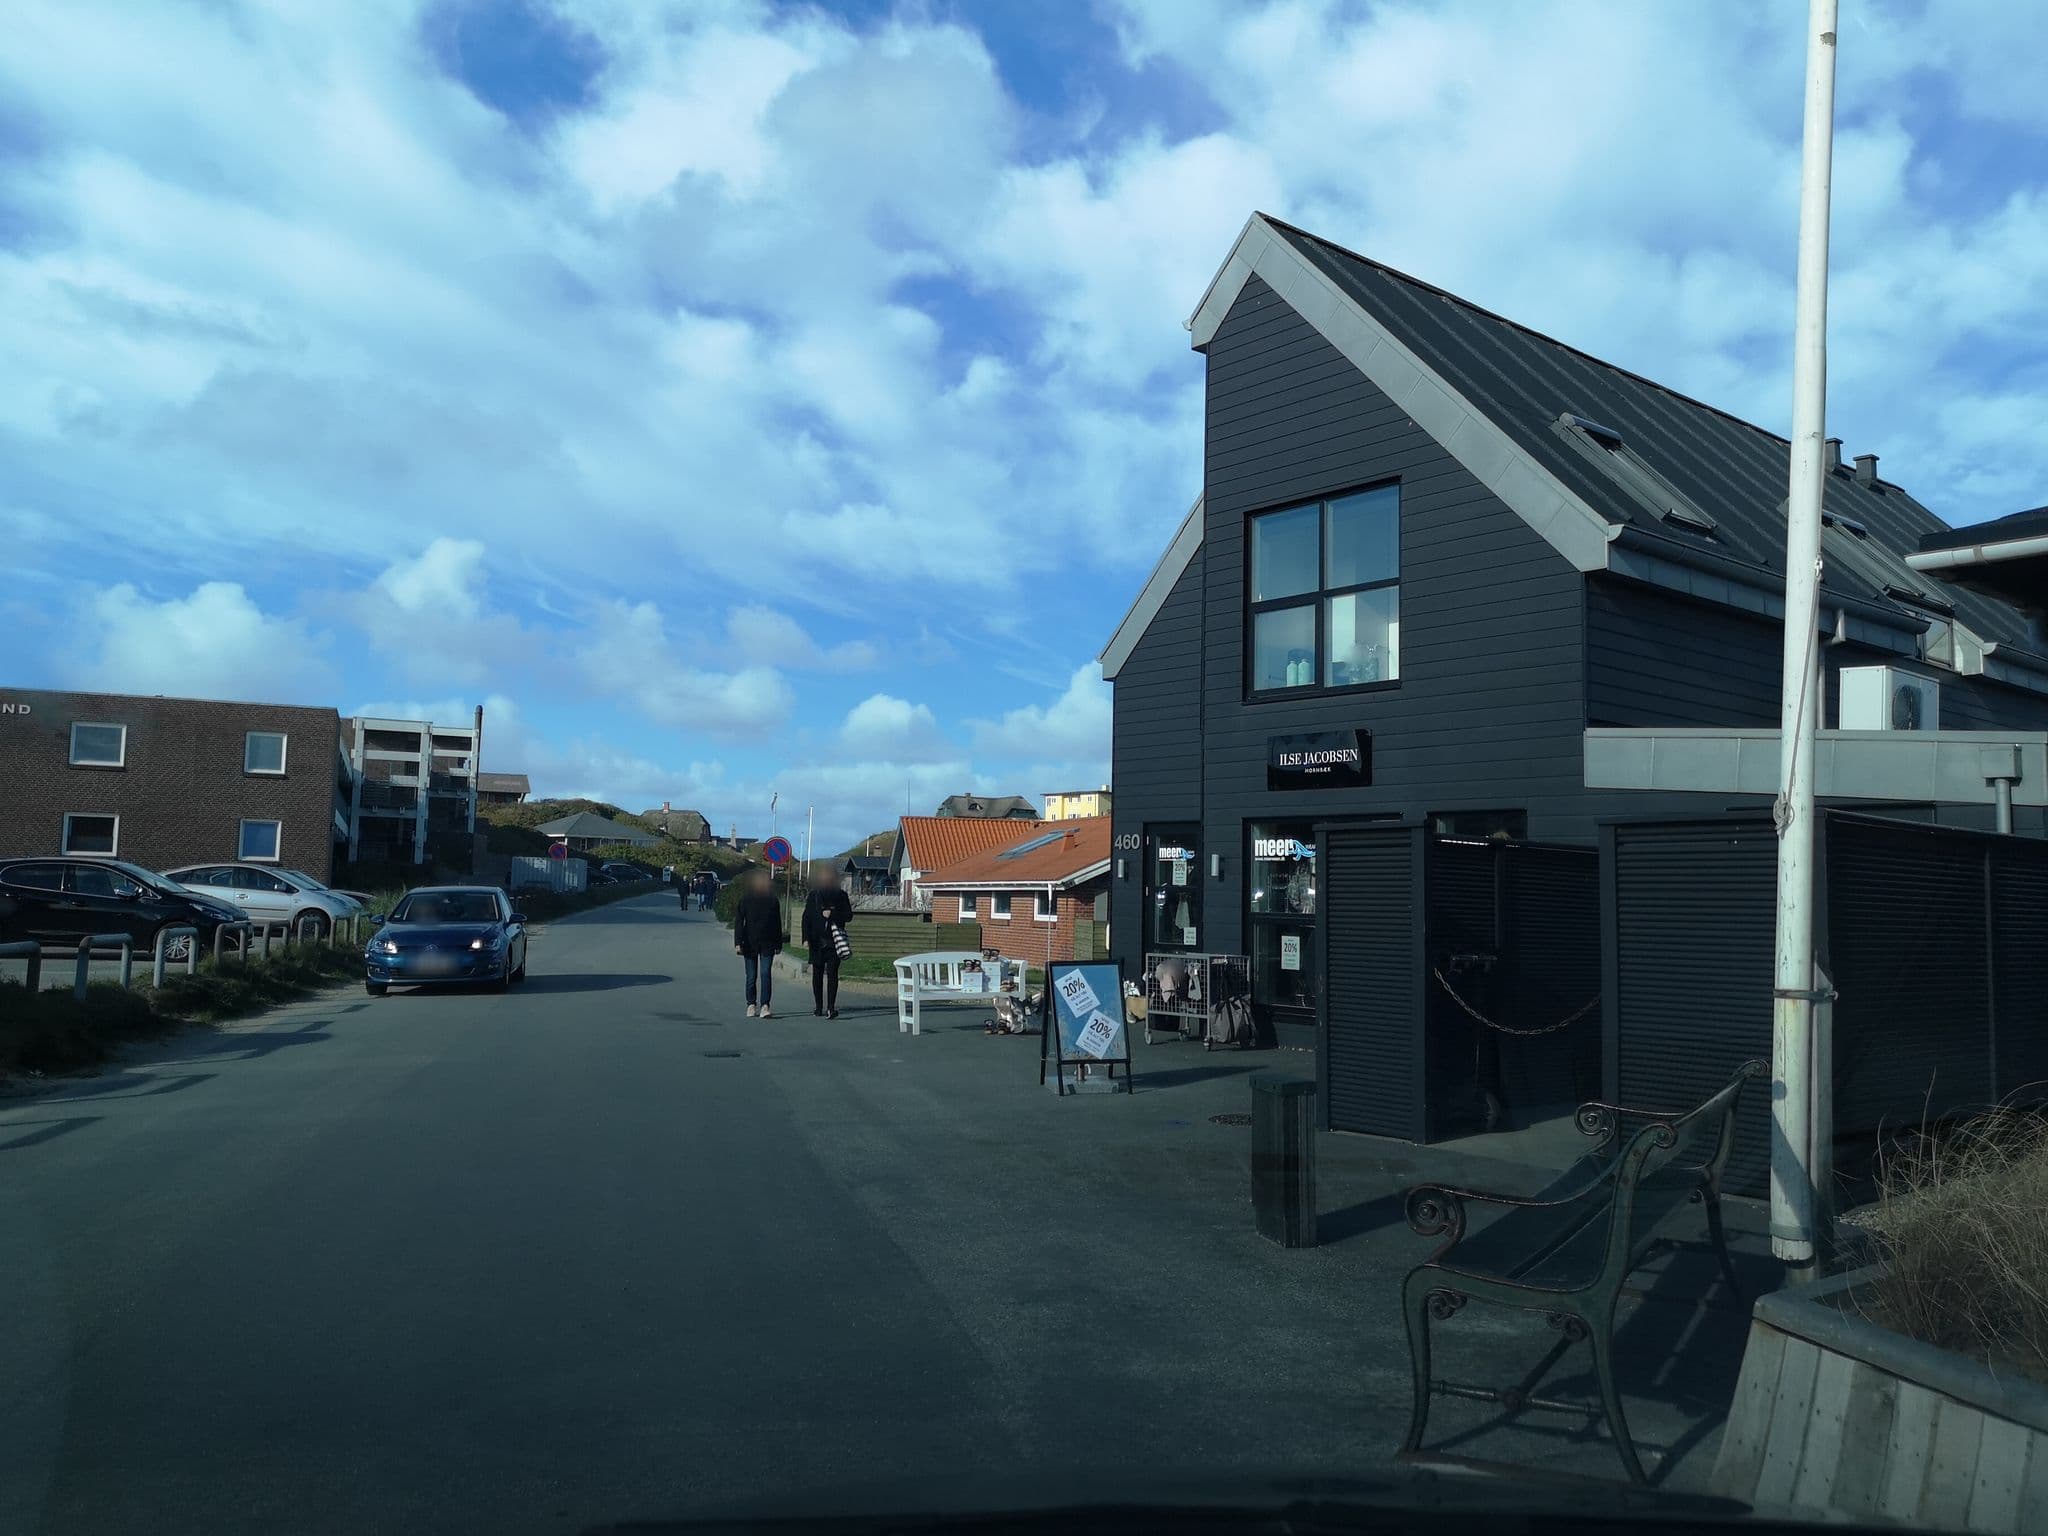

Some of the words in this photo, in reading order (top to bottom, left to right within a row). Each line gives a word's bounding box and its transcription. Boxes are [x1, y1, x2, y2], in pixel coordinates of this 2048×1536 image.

[1279, 753, 1302, 766] ILSE
[1302, 748, 1359, 765] JACOBSEN
[1115, 834, 1140, 850] 460
[1284, 942, 1297, 953] 20%
[1063, 977, 1085, 997] 20%
[1090, 1019, 1112, 1039] 20%
